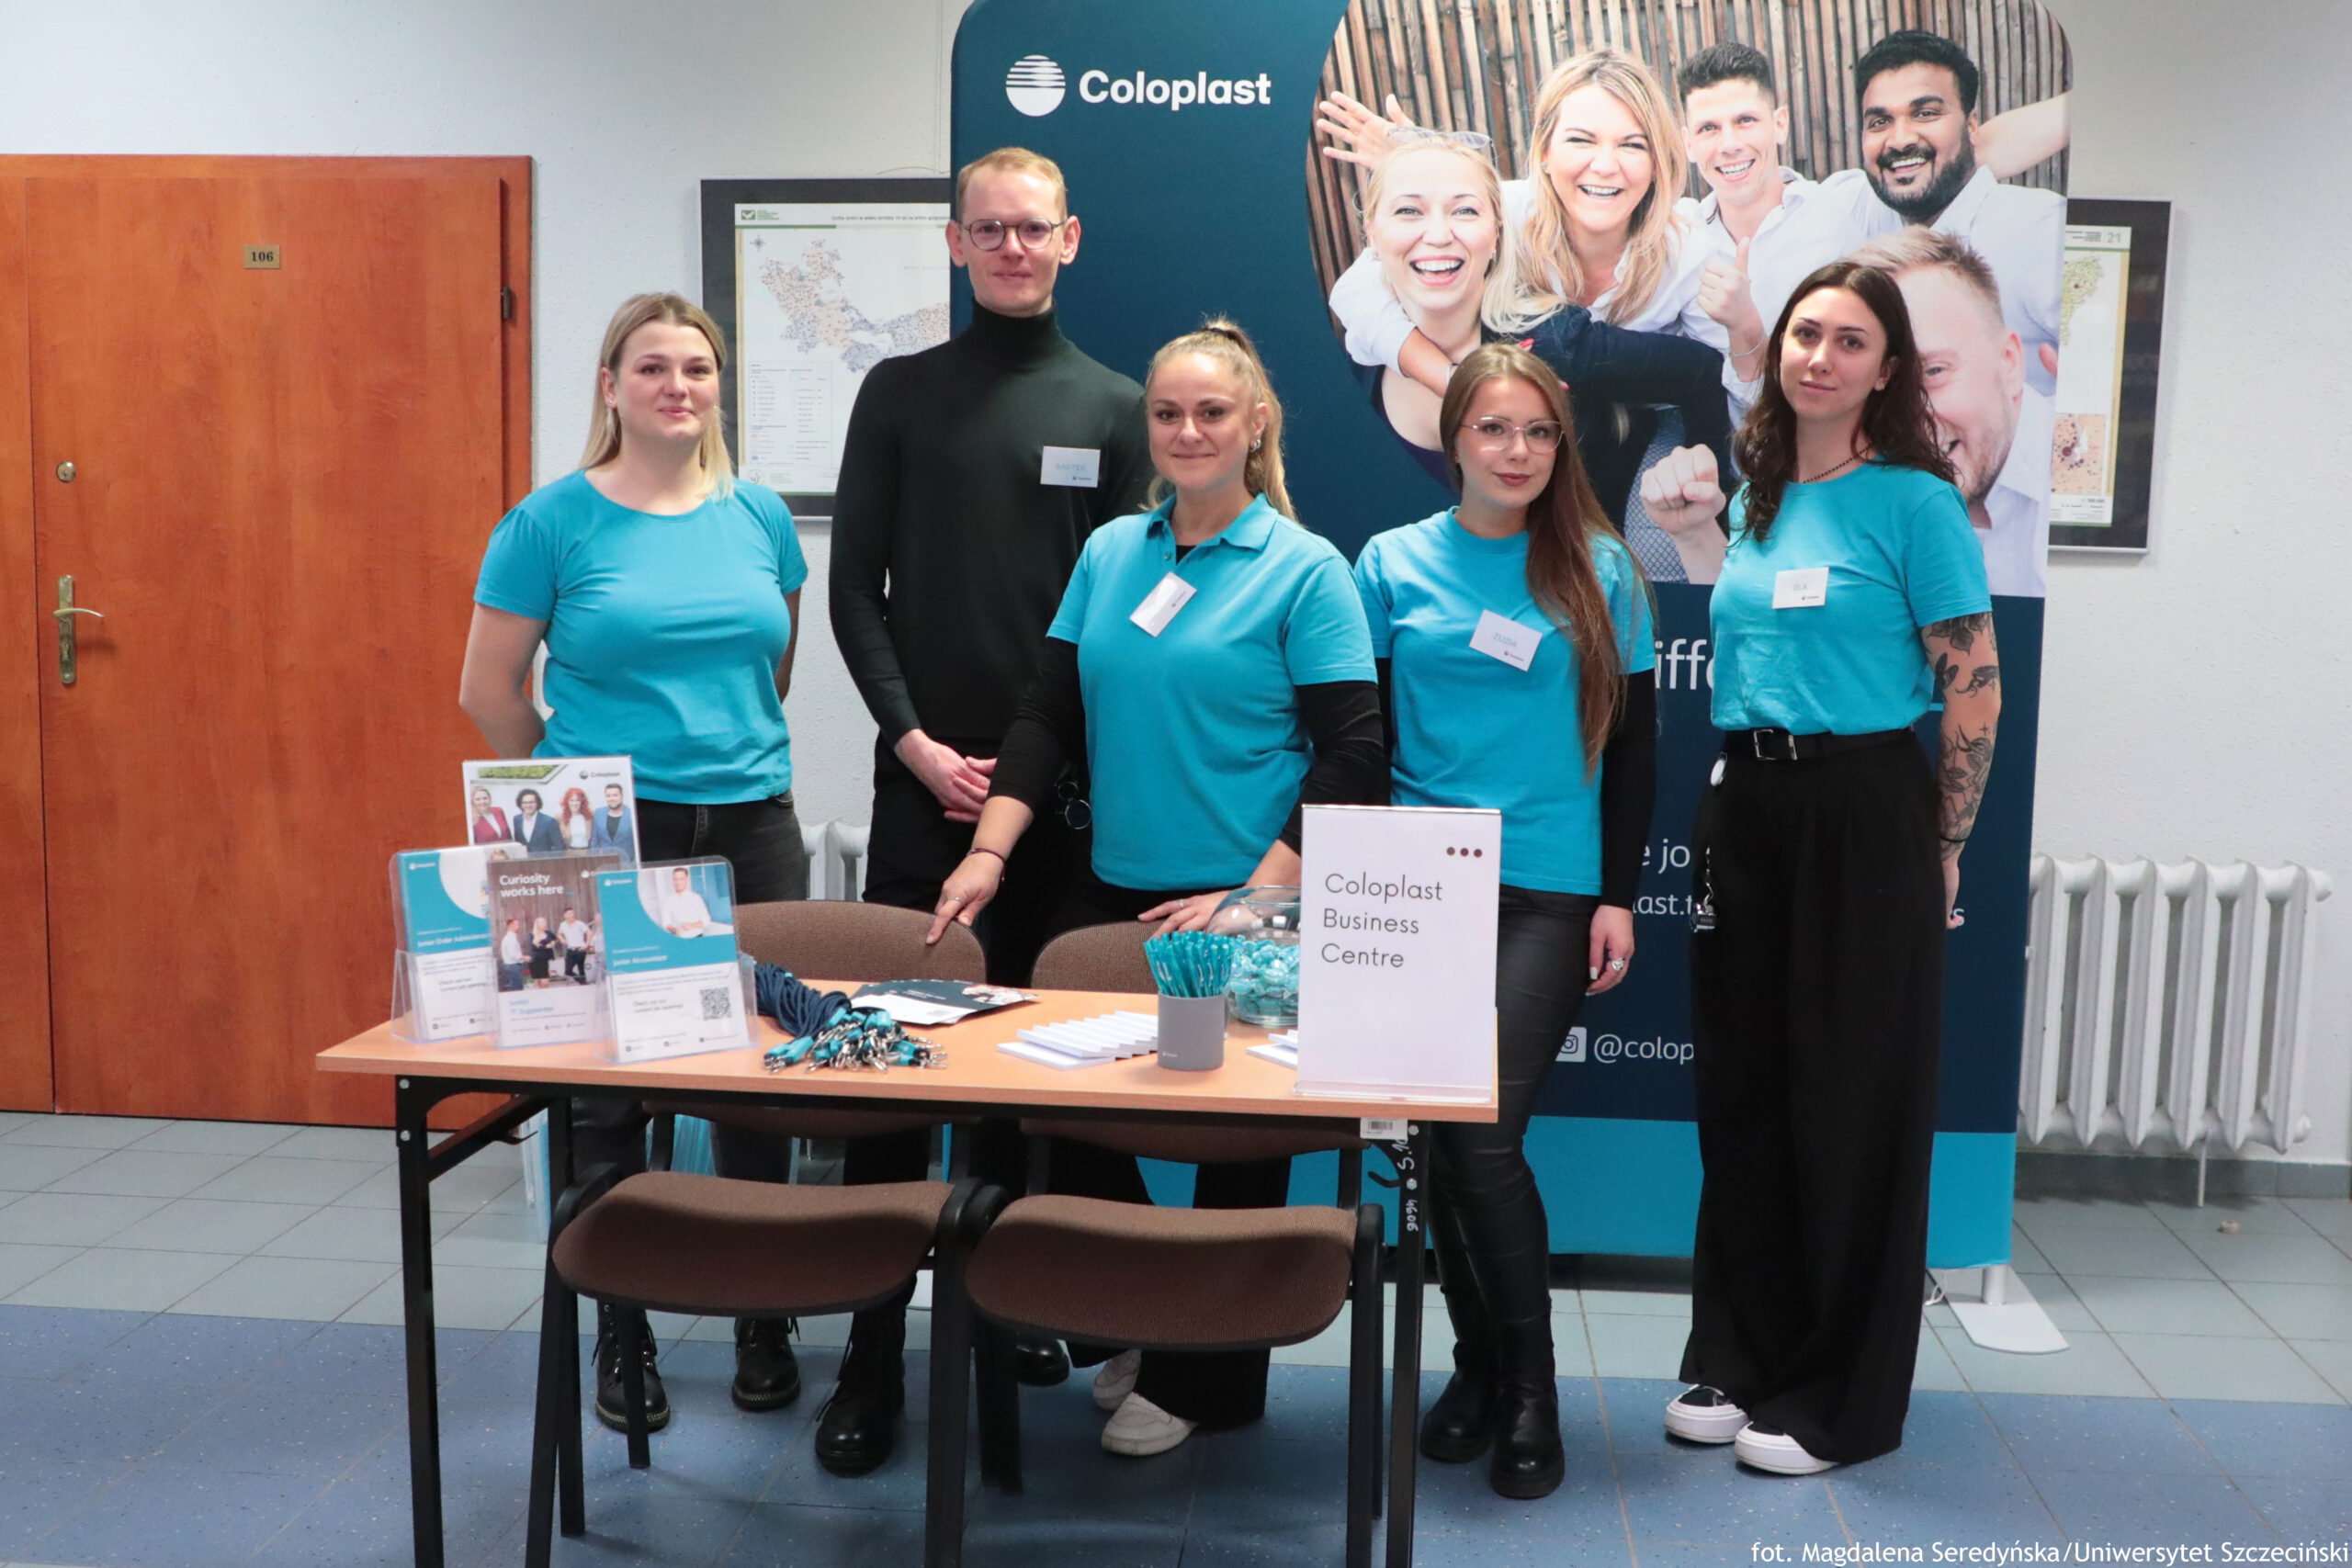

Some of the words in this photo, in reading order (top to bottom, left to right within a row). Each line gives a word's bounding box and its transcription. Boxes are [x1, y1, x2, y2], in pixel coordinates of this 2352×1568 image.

[1079, 69, 1272, 111] Coloplast
[252, 251, 274, 263] 106
[499, 873, 550, 886] Curiosity
[500, 886, 537, 897] works
[537, 885, 564, 896] here
[1325, 871, 1443, 904] Coloplast
[1323, 908, 1419, 934] Business
[1321, 942, 1405, 968] Centre
[1593, 1033, 1694, 1066] @colop
